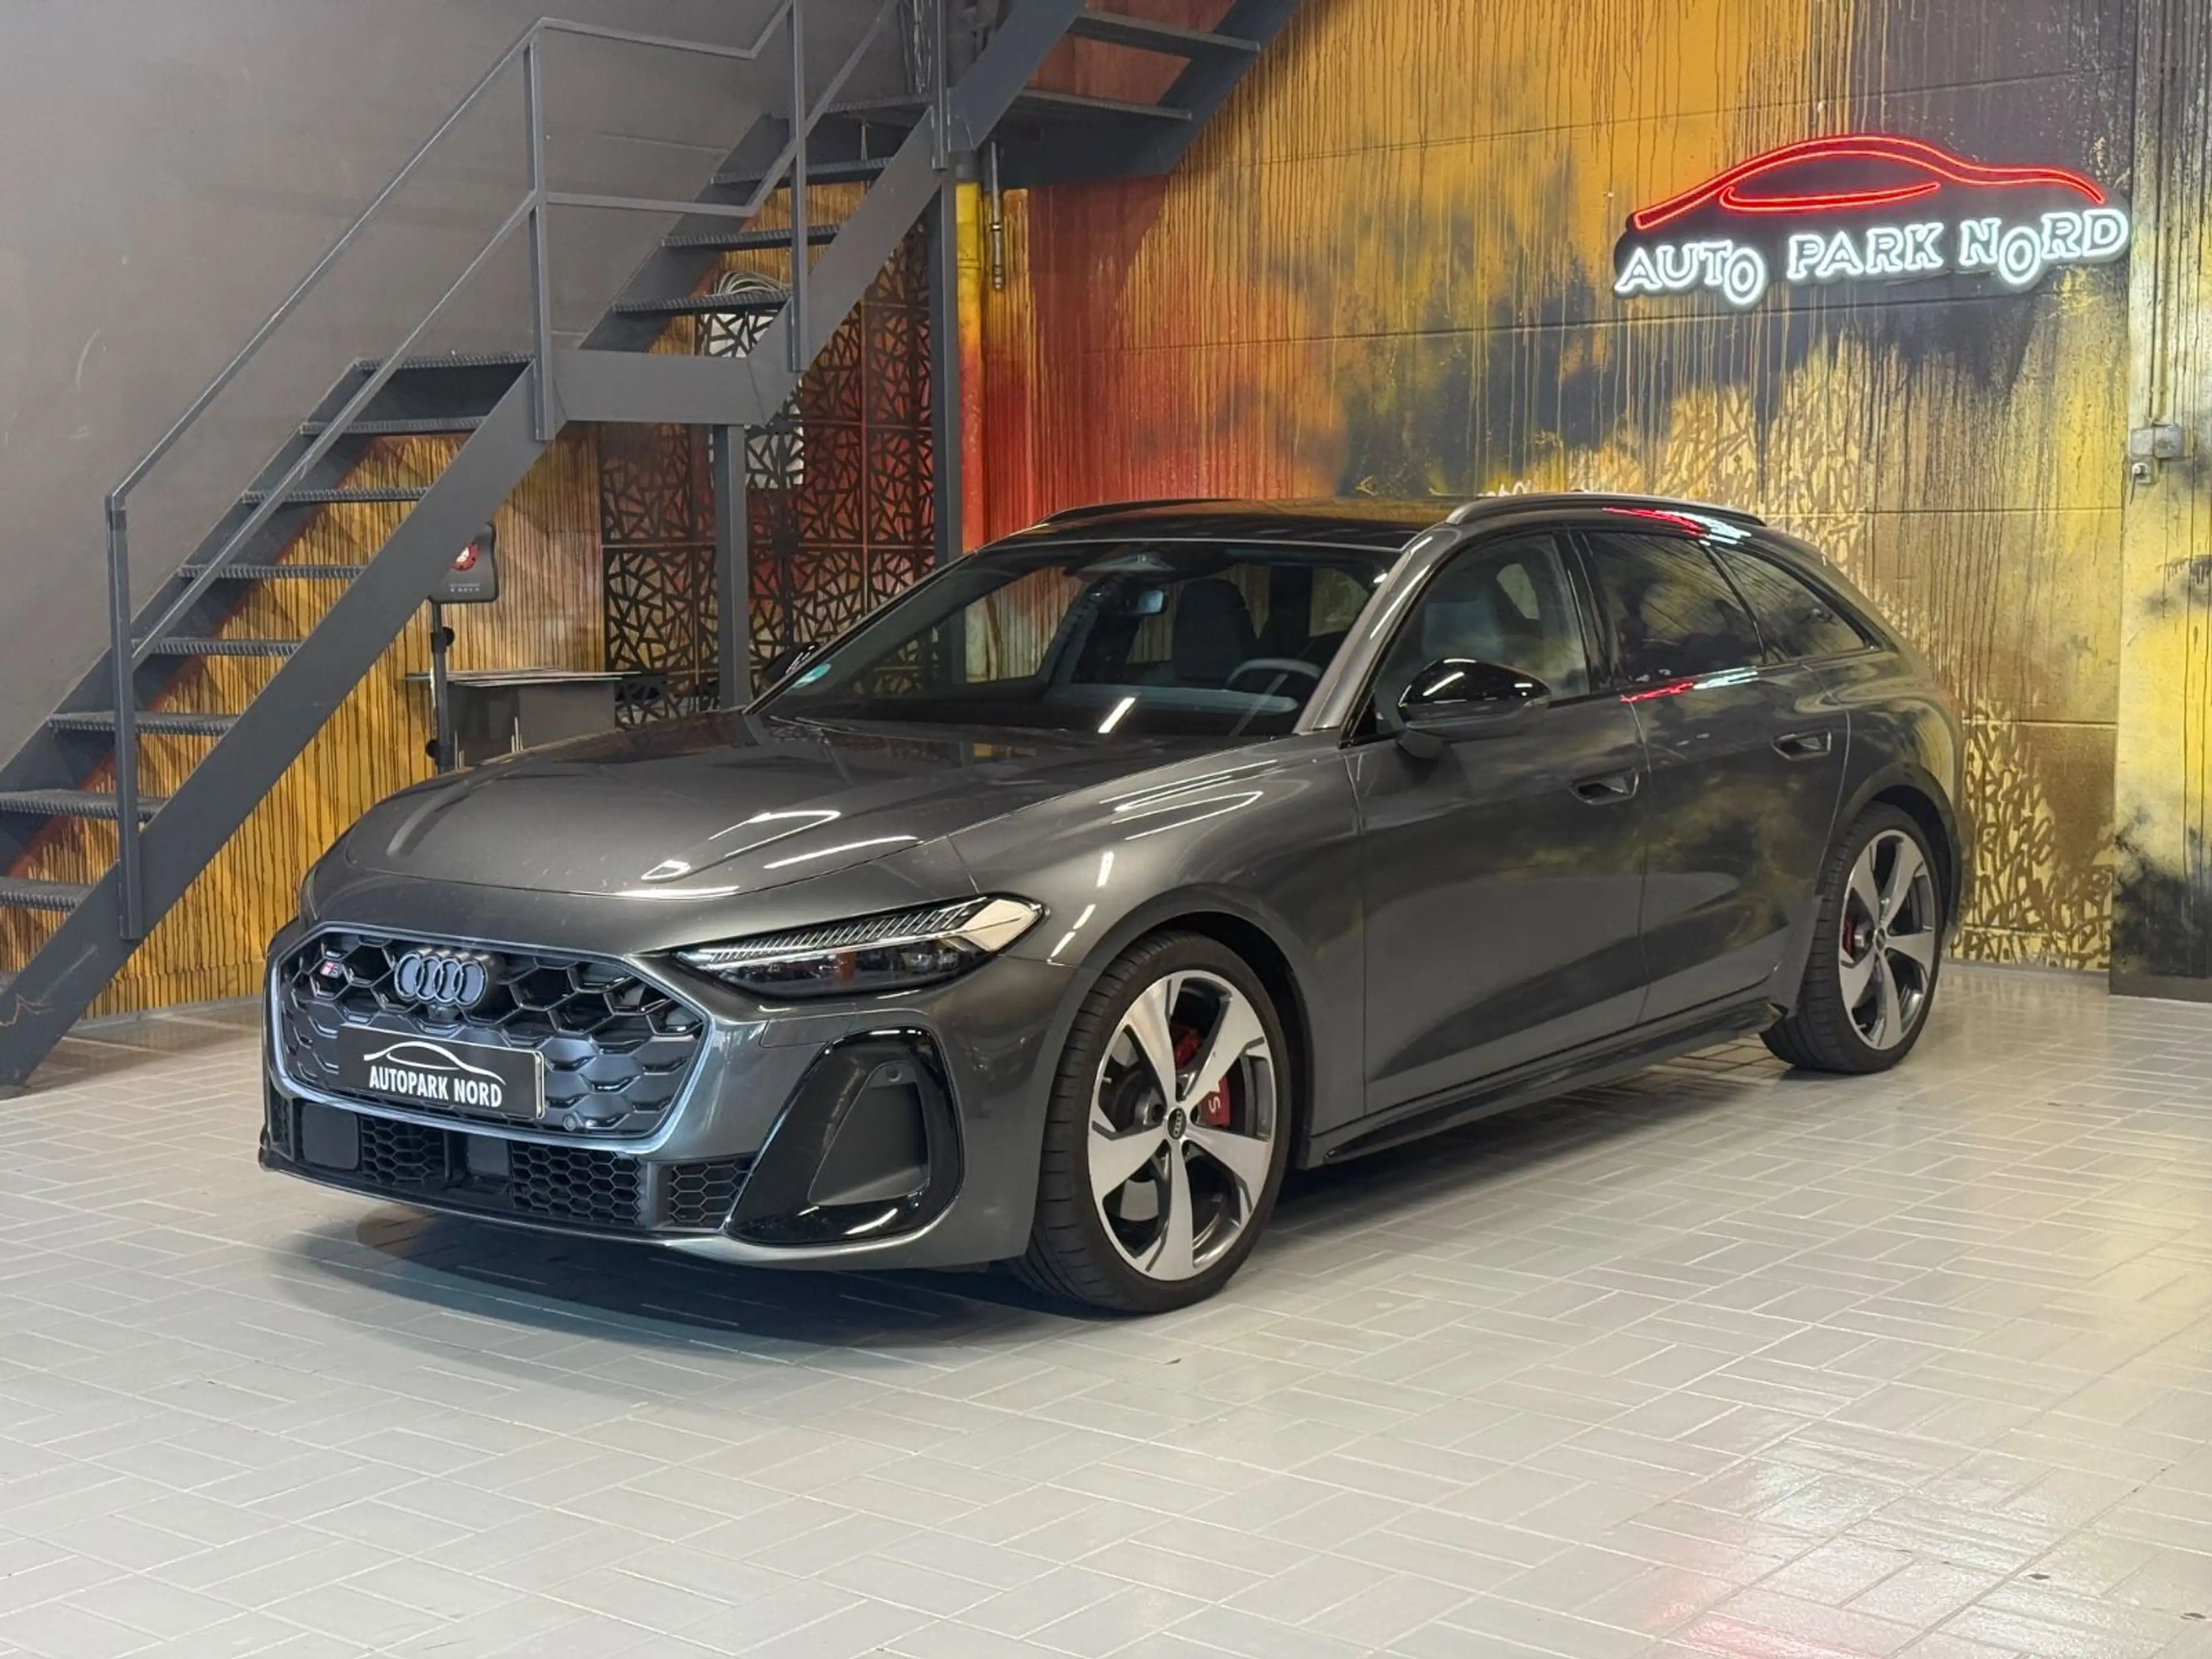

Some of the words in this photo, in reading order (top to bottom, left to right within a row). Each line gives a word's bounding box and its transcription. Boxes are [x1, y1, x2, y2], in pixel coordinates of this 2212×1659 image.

[1614, 238, 1766, 305] AUTO
[1786, 222, 1945, 281] PARK
[1958, 208, 2129, 285] NORD
[369, 1065, 449, 1100] AUTOPARK
[453, 1078, 502, 1108] NORD
[1208, 1095, 1221, 1114] S
